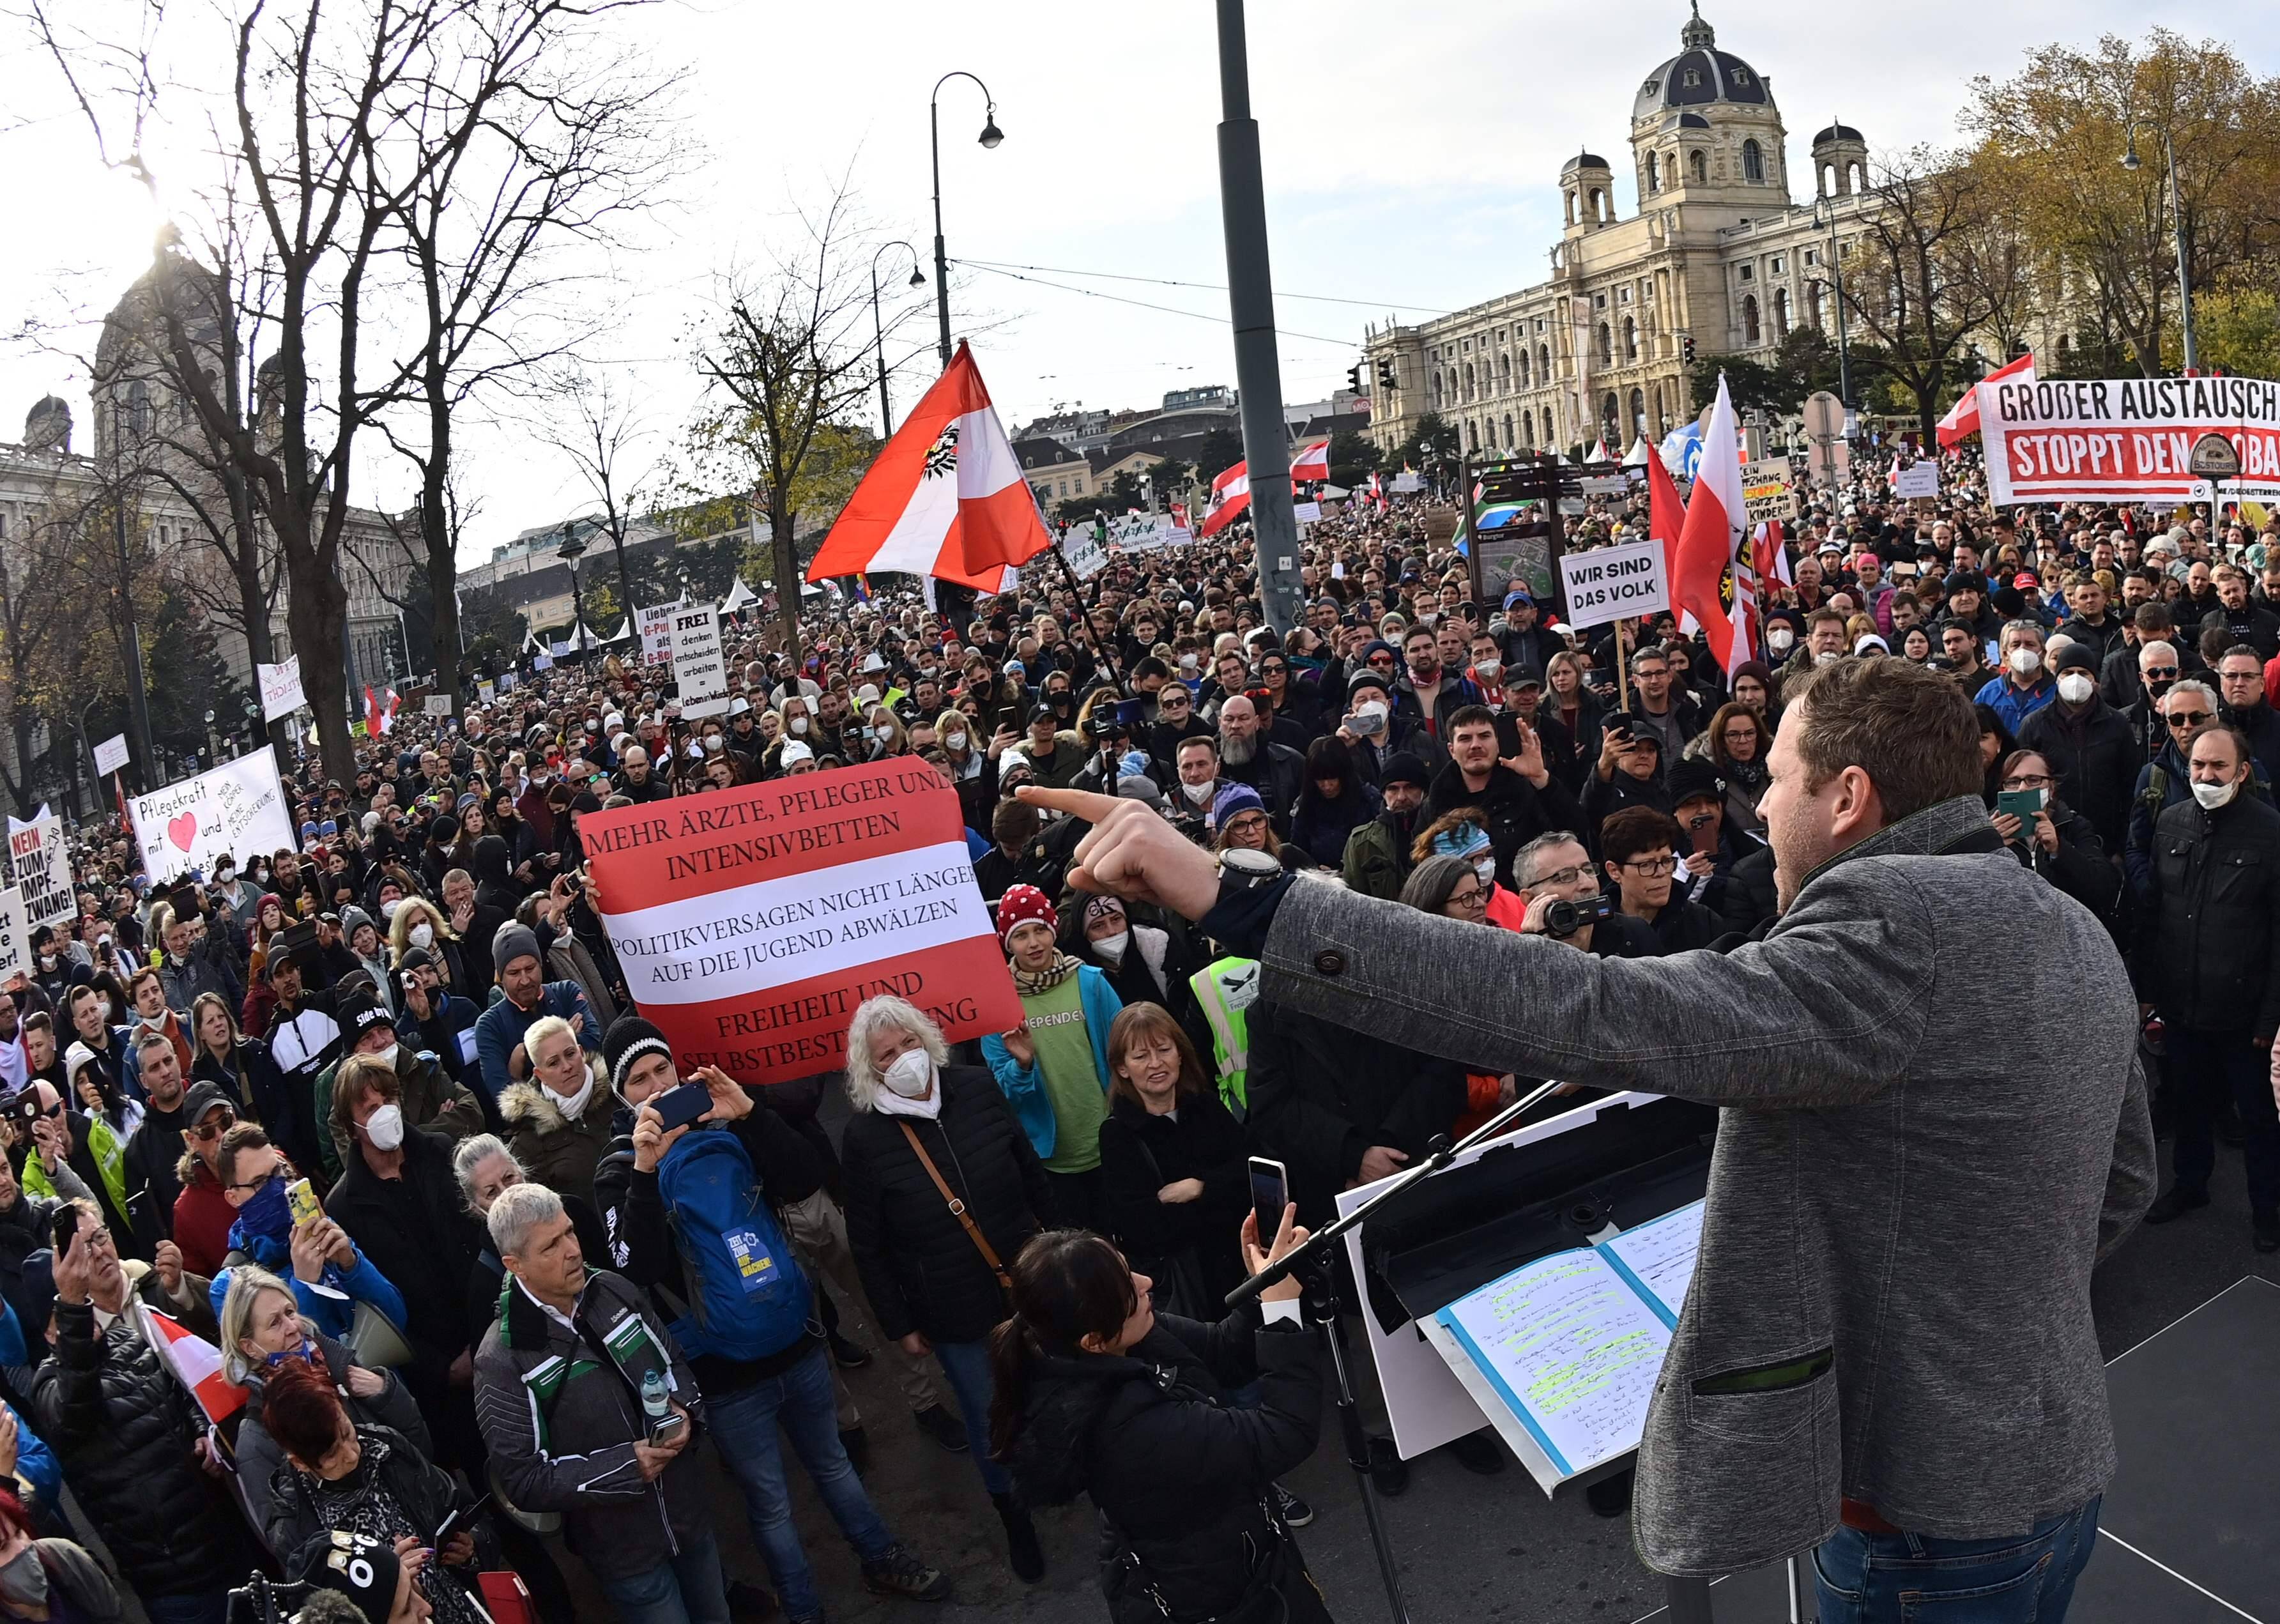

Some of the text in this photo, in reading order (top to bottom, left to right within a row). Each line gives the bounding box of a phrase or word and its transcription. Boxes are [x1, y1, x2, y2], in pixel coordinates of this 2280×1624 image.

[2000, 379, 2280, 425] GROßER AUSTAUSCH
[2012, 434, 2123, 477] STOPPT
[2133, 432, 2189, 475] DEN
[1569, 557, 1652, 586] WIR SIND
[1573, 578, 1656, 609] DAS VOLK
[676, 612, 710, 631] FREI
[681, 632, 713, 646] denken
[675, 647, 720, 664] entscheiden
[683, 664, 718, 677] arbeiten
[703, 694, 710, 702] in
[139, 781, 206, 822] Pflegekraft
[227, 803, 245, 827] MEINE
[586, 818, 671, 857] MEHR
[678, 799, 775, 838] ÄRZTE,
[779, 777, 895, 817] PFLEGER
[11, 827, 41, 857] NEIN
[148, 813, 222, 855] mit und
[666, 811, 901, 881] INTENSIVBETTEN
[15, 850, 45, 880] ZUM
[20, 871, 57, 902] IMPF-
[24, 887, 73, 924] ZWANG!
[611, 899, 820, 956] POLITIKVERSAGEN
[821, 882, 891, 915] NICHT
[651, 898, 960, 983] AUF DIE JUGEND ABWÄLZEN
[356, 1010, 374, 1027] Side
[715, 988, 850, 1039] FREIHEIT
[728, 1234, 743, 1249] ZEIT
[732, 1243, 750, 1258] ZUM
